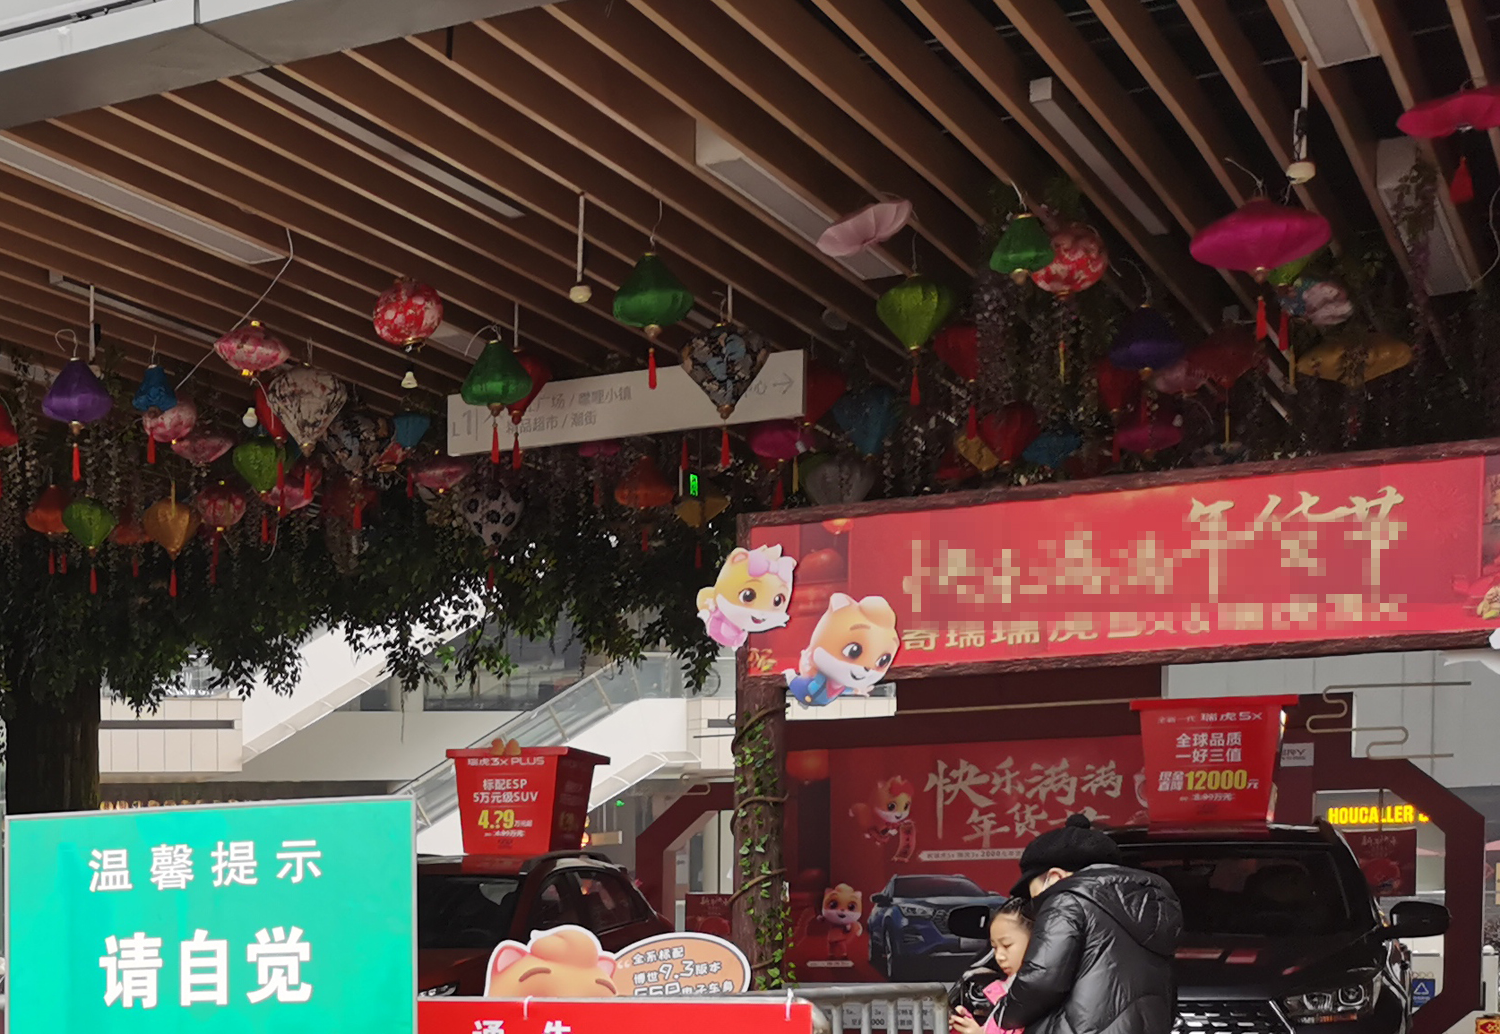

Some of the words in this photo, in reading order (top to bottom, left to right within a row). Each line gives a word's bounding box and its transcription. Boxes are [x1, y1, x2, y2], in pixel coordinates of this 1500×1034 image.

[1175, 731, 1242, 748] 全球品质
[510, 756, 545, 766] PLUS
[1175, 748, 1242, 764] 一好三值
[482, 778, 528, 791] 标配ESP
[472, 791, 539, 804] 5万元级SUV
[924, 755, 1124, 841] 快乐满满
[88, 838, 323, 893] 温馨提示
[632, 945, 686, 966] 全系标配
[98, 925, 313, 1009] 请自觉
[633, 959, 722, 985] 博世9.3版本
